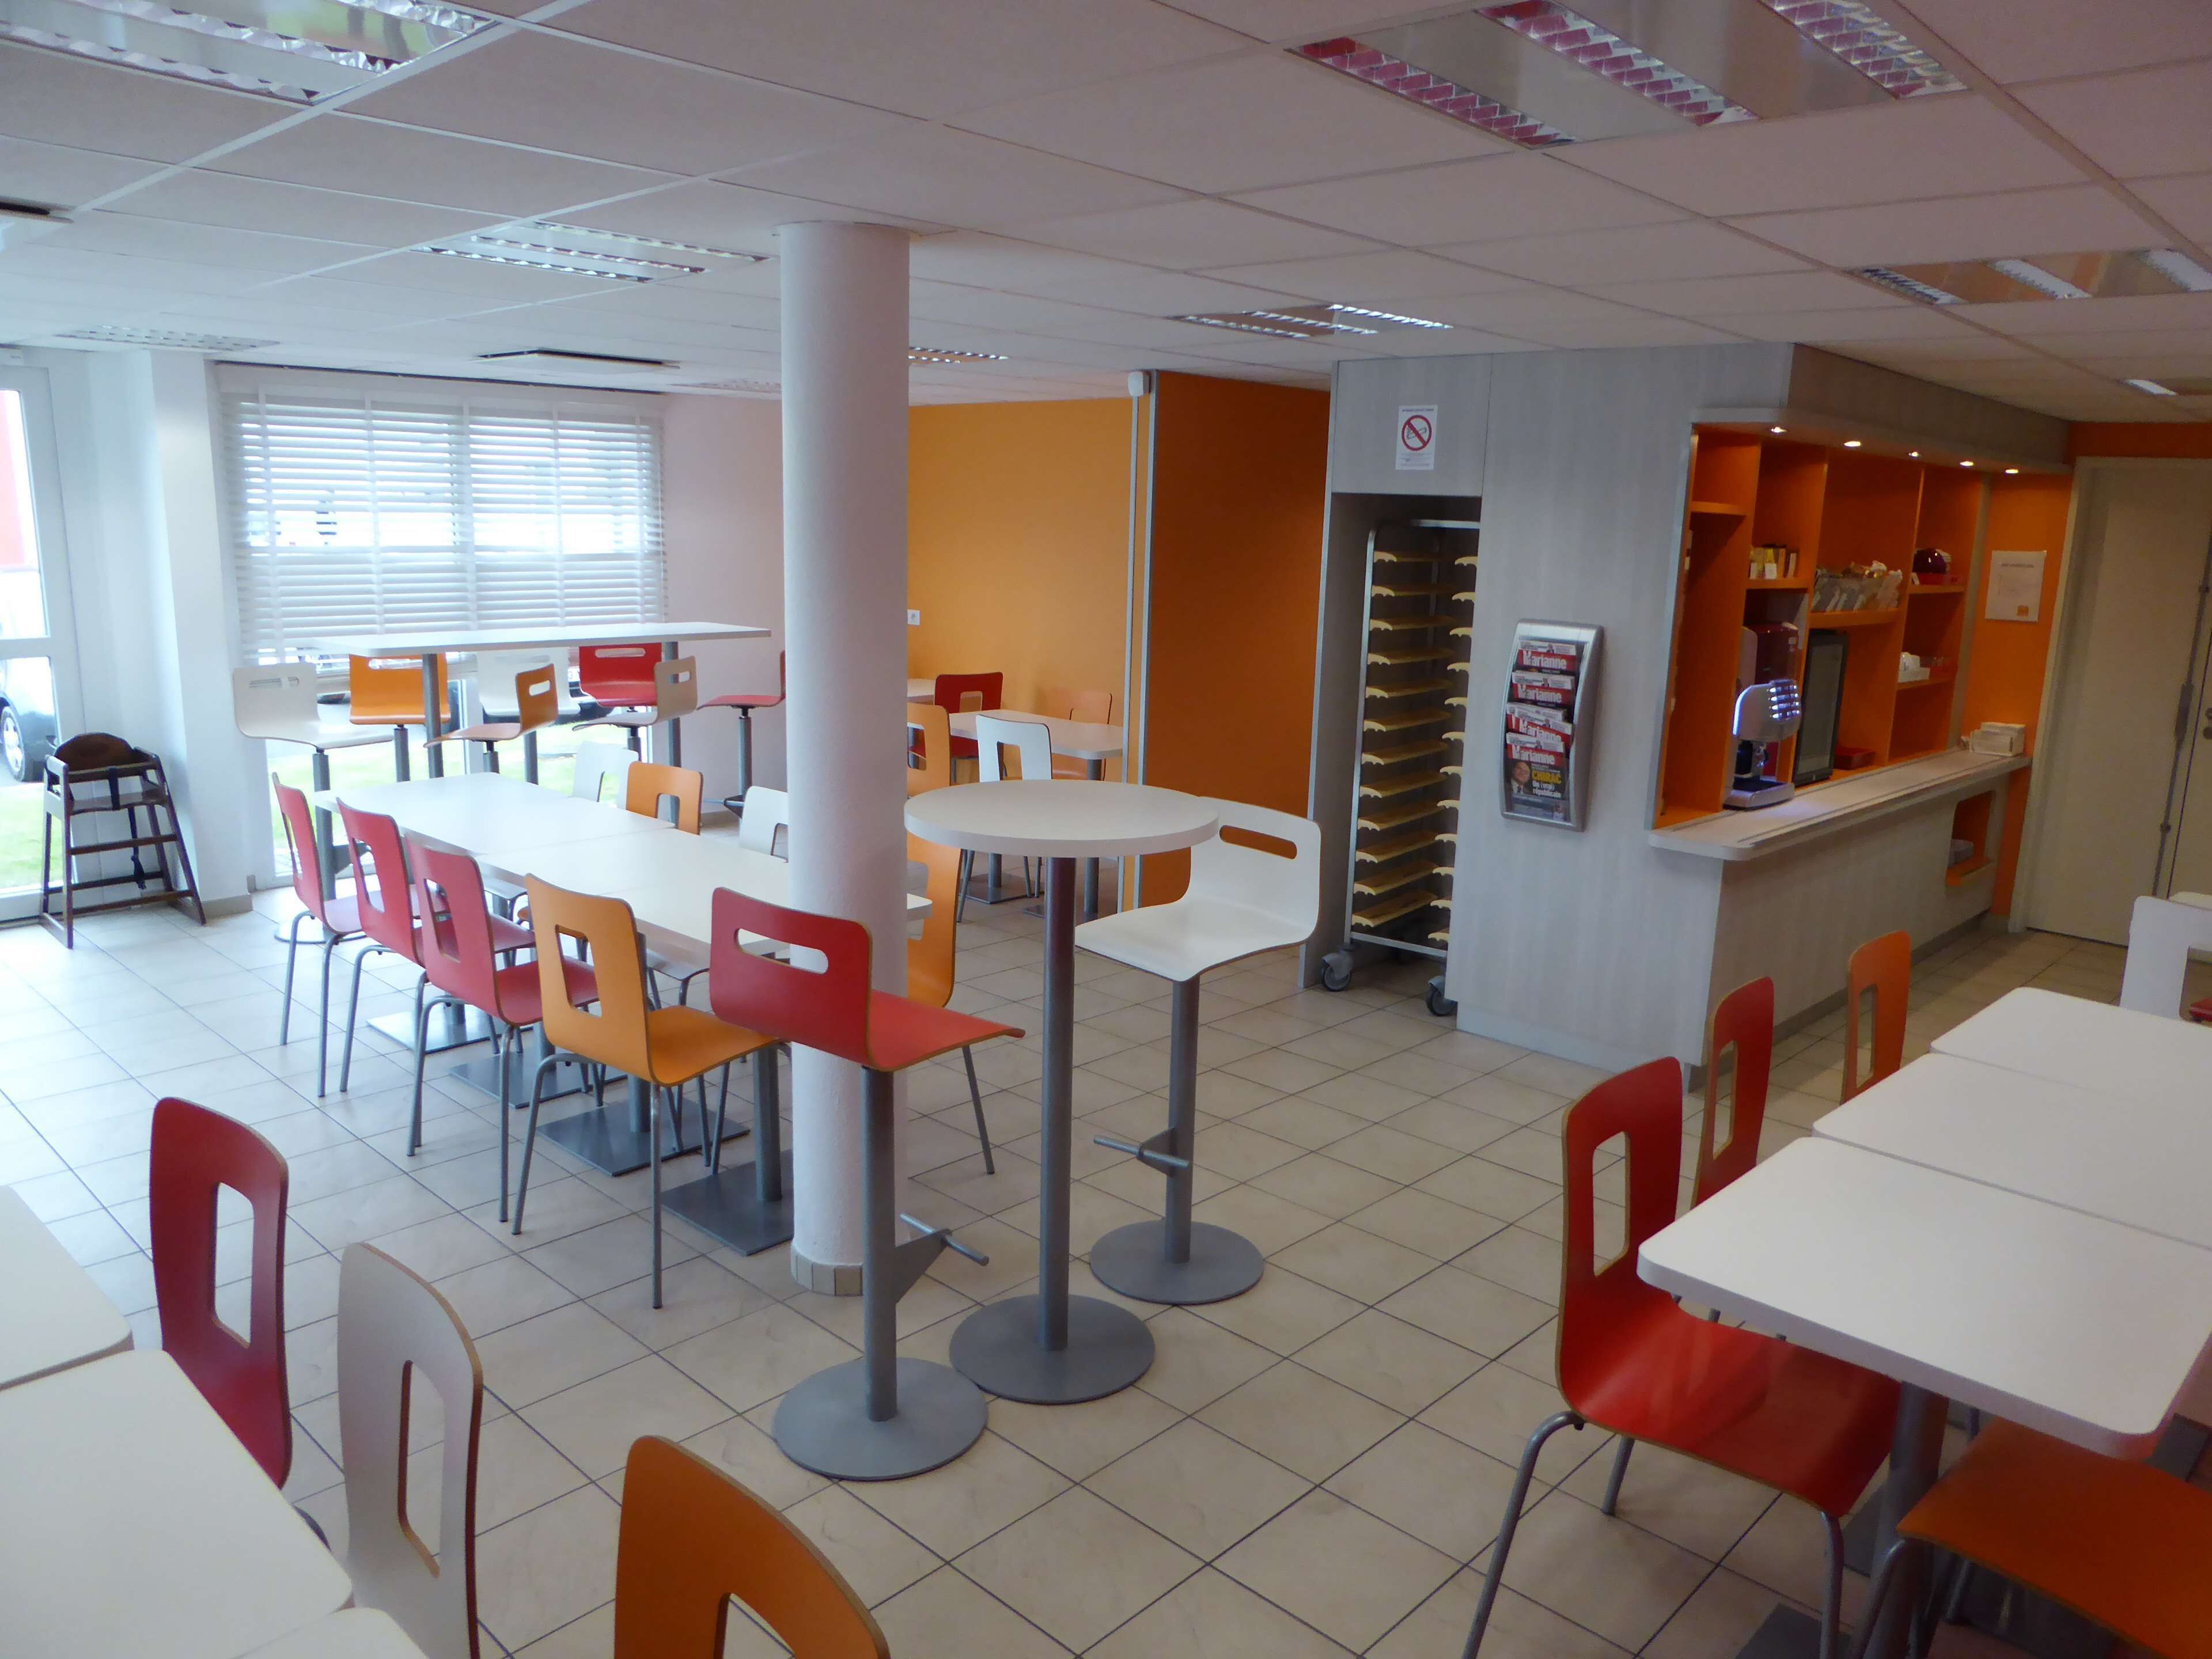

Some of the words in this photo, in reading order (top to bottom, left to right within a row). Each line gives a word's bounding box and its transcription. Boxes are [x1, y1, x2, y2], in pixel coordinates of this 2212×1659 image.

[1523, 650, 1567, 669] Marianne
[1518, 684, 1562, 704] Marianne
[1512, 744, 1555, 765] Marianne
[1532, 770, 1562, 784] CHIRAC
